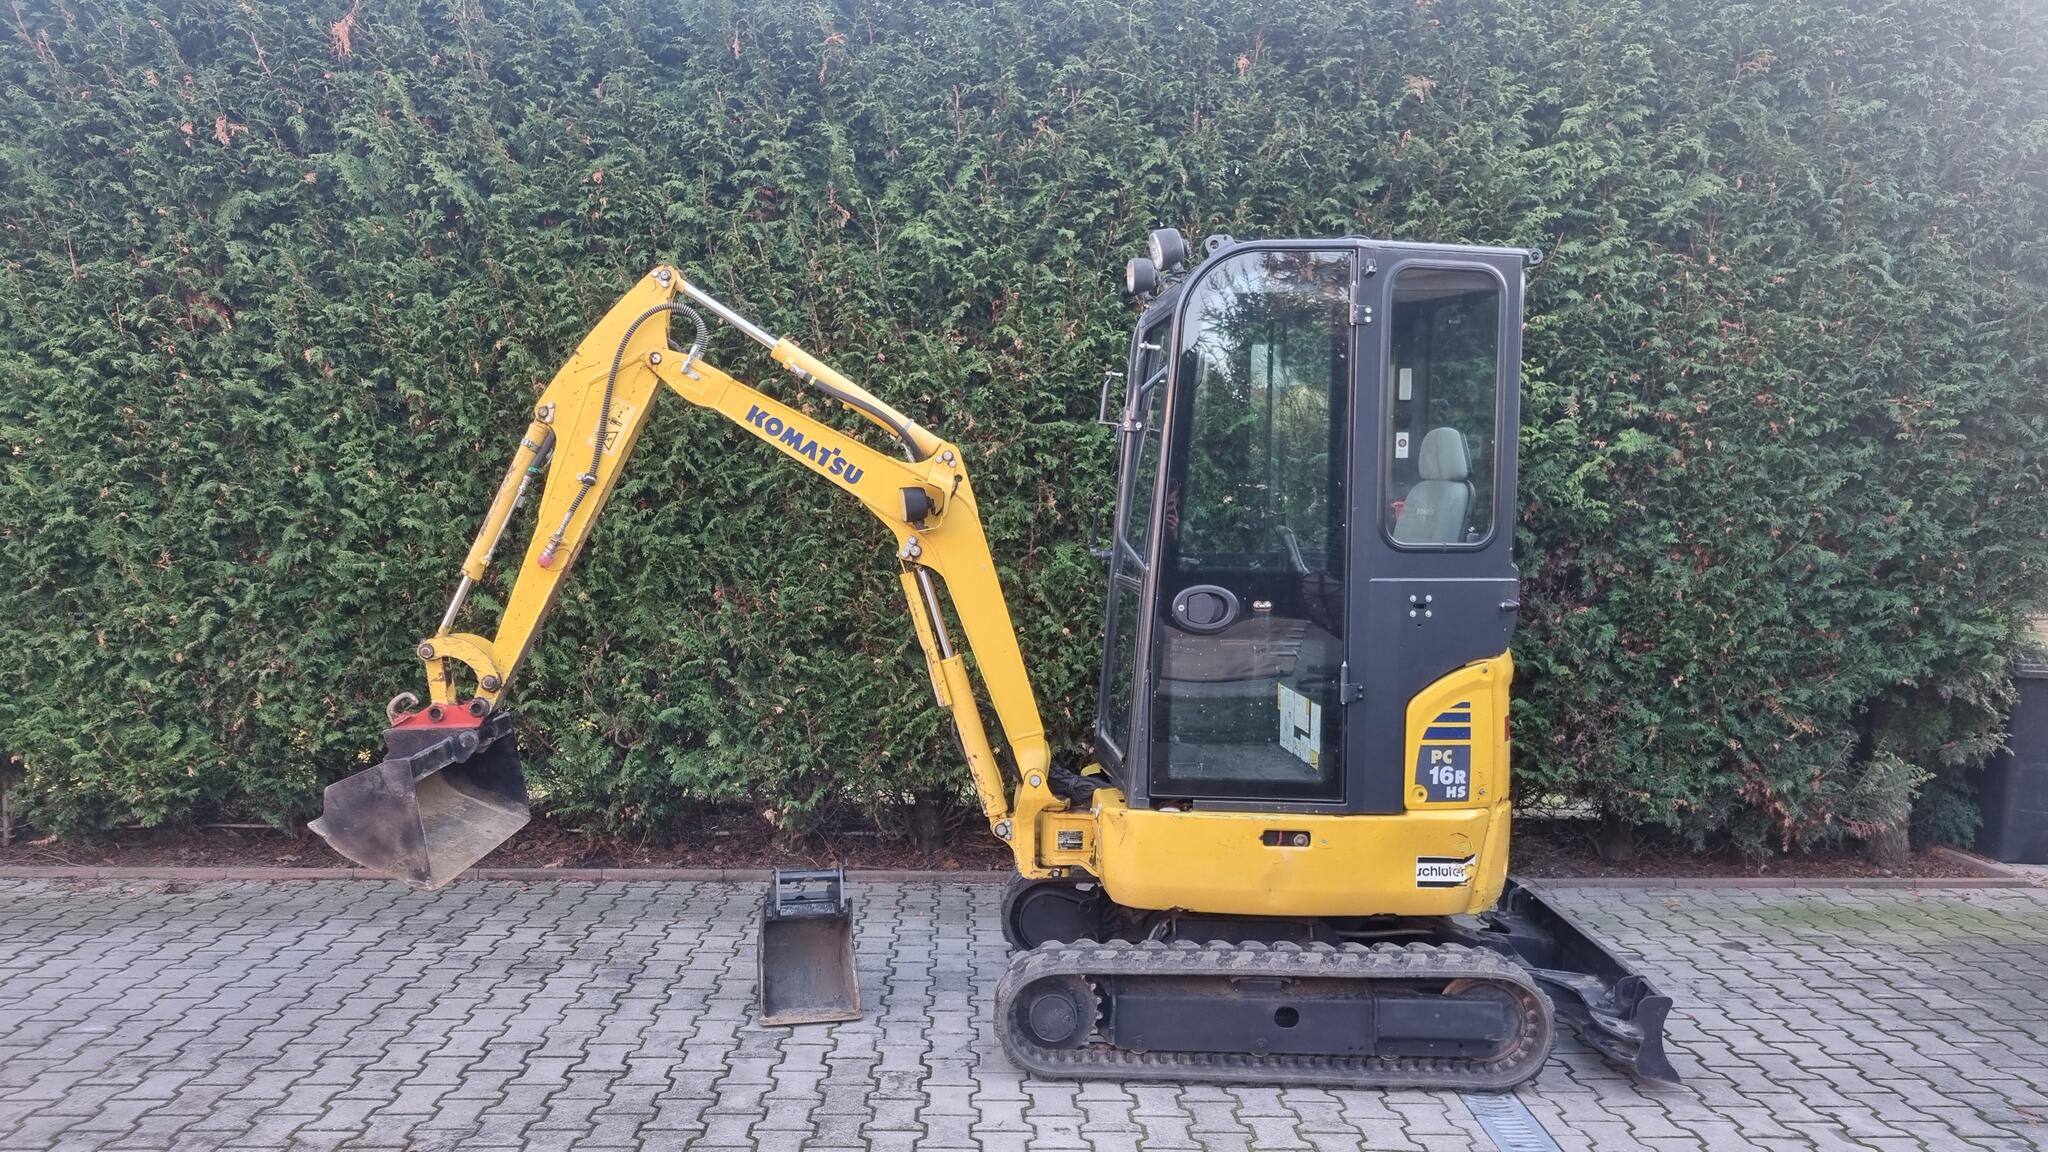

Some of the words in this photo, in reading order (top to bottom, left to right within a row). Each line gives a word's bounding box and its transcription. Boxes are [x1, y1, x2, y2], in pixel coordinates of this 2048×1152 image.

[745, 404, 864, 484] KOMATSU
[1430, 750, 1453, 764] PC
[1429, 766, 1466, 785] 16R
[1446, 786, 1466, 798] HS
